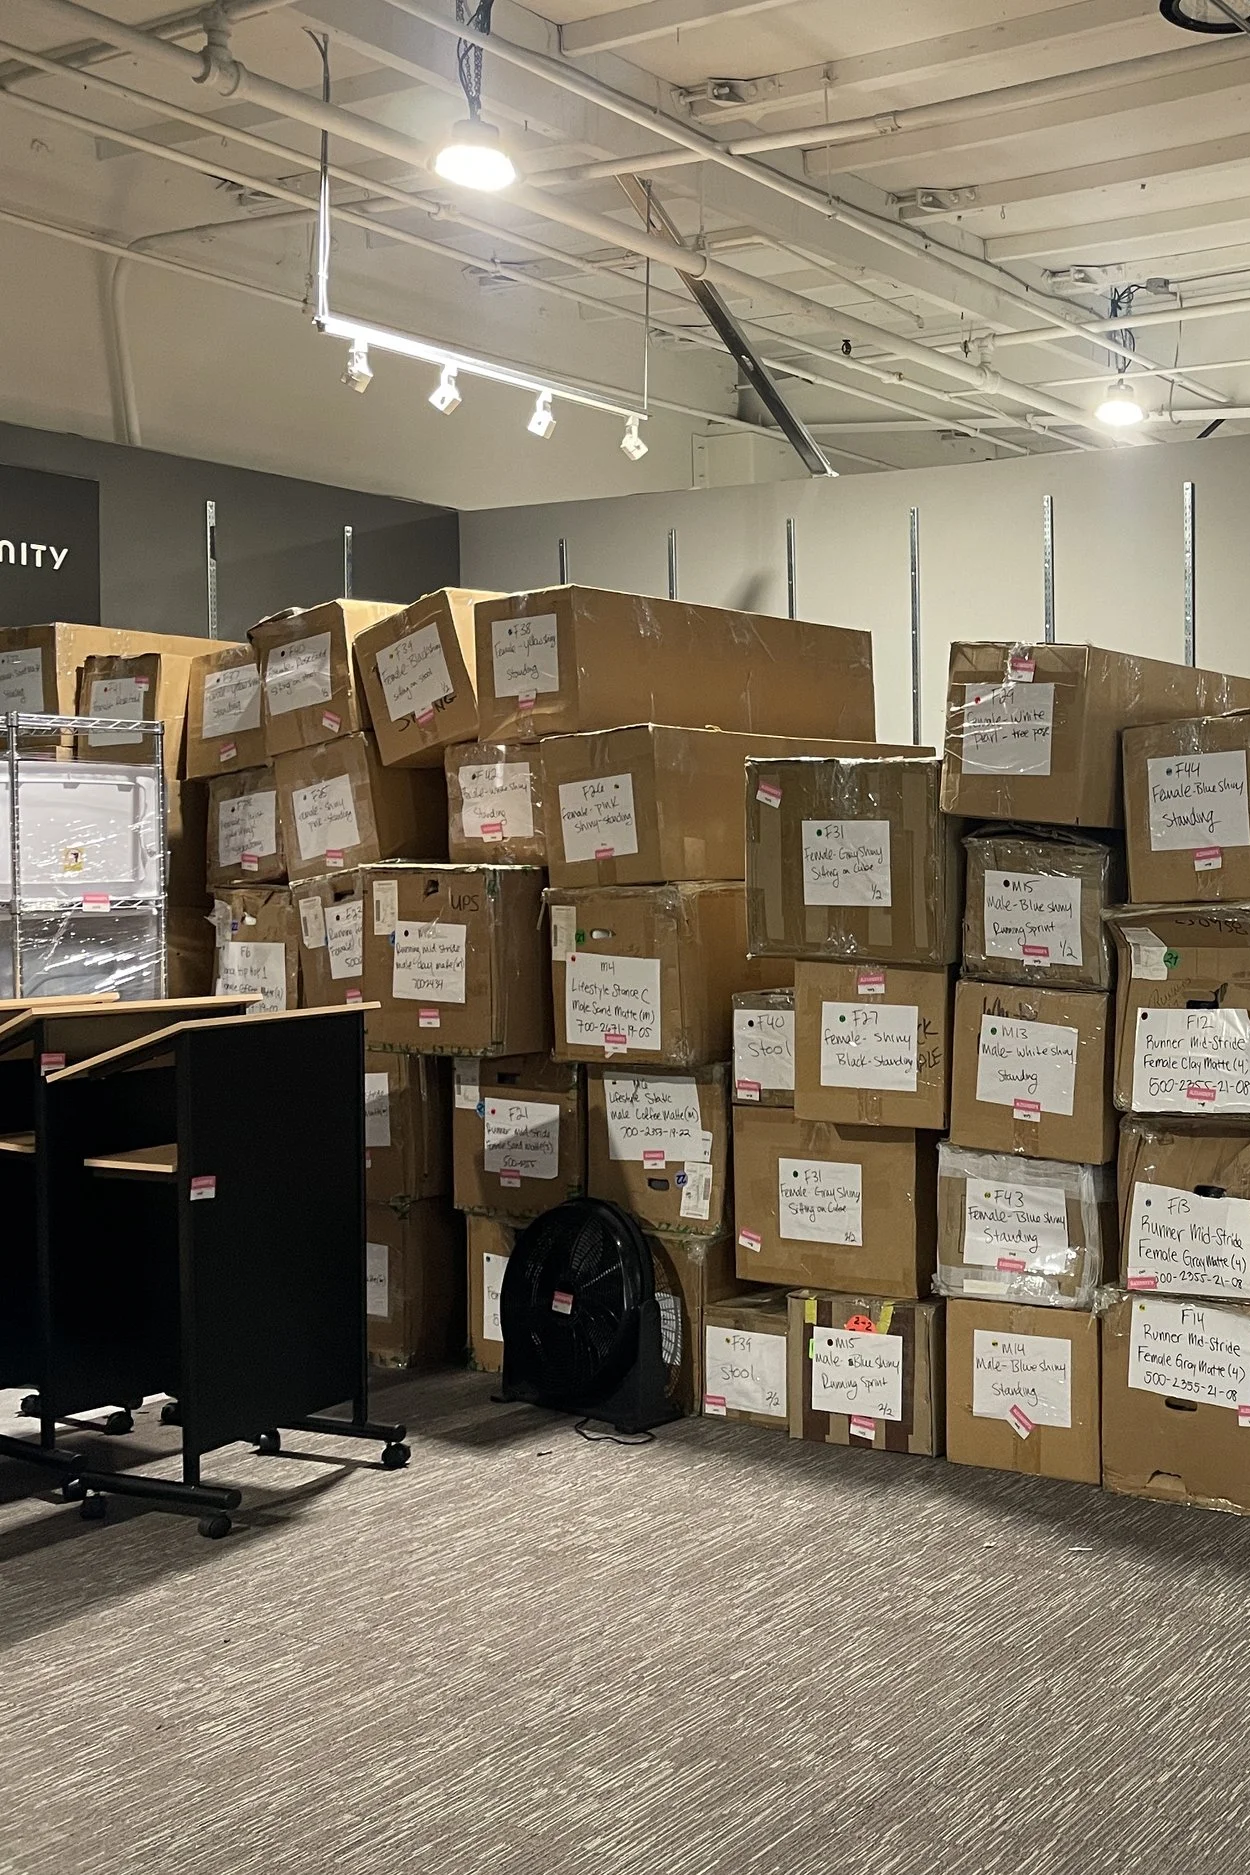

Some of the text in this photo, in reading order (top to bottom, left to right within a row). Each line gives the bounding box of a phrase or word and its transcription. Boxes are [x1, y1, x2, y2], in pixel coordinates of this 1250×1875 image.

[1176, 762, 1201, 779] F44
[1162, 807, 1222, 833] Standing
[825, 825, 844, 839] F31
[1012, 880, 1039, 893] M15
[450, 894, 480, 911] UPS
[1020, 900, 1044, 911] Blue
[1026, 922, 1055, 936] Sprint
[592, 1002, 612, 1015] Sand
[758, 1014, 785, 1030] F40
[853, 1009, 878, 1026] F27
[1187, 1015, 1214, 1030] F12
[1002, 1025, 1029, 1039] M13
[1146, 1036, 1184, 1049] Runner
[1143, 1055, 1201, 1075] Female Clay
[804, 1169, 821, 1184] F31
[994, 1190, 1024, 1208] F43
[1012, 1211, 1040, 1223] Blue
[1142, 1215, 1186, 1241] Runner
[984, 1228, 1040, 1253] Standing
[1138, 1239, 1178, 1262] Female
[1183, 1251, 1205, 1268] Gray
[1181, 1309, 1204, 1331] F14
[1144, 1324, 1183, 1343] Runner
[1002, 1343, 1025, 1355] M14
[1137, 1346, 1172, 1366] Female
[1012, 1360, 1038, 1373] Blue
[1144, 1371, 1238, 1401] 500-2355-21-08
[766, 1391, 780, 1406] 2/2
[992, 1382, 1038, 1407] Standing
[878, 1403, 894, 1417] 2/2
